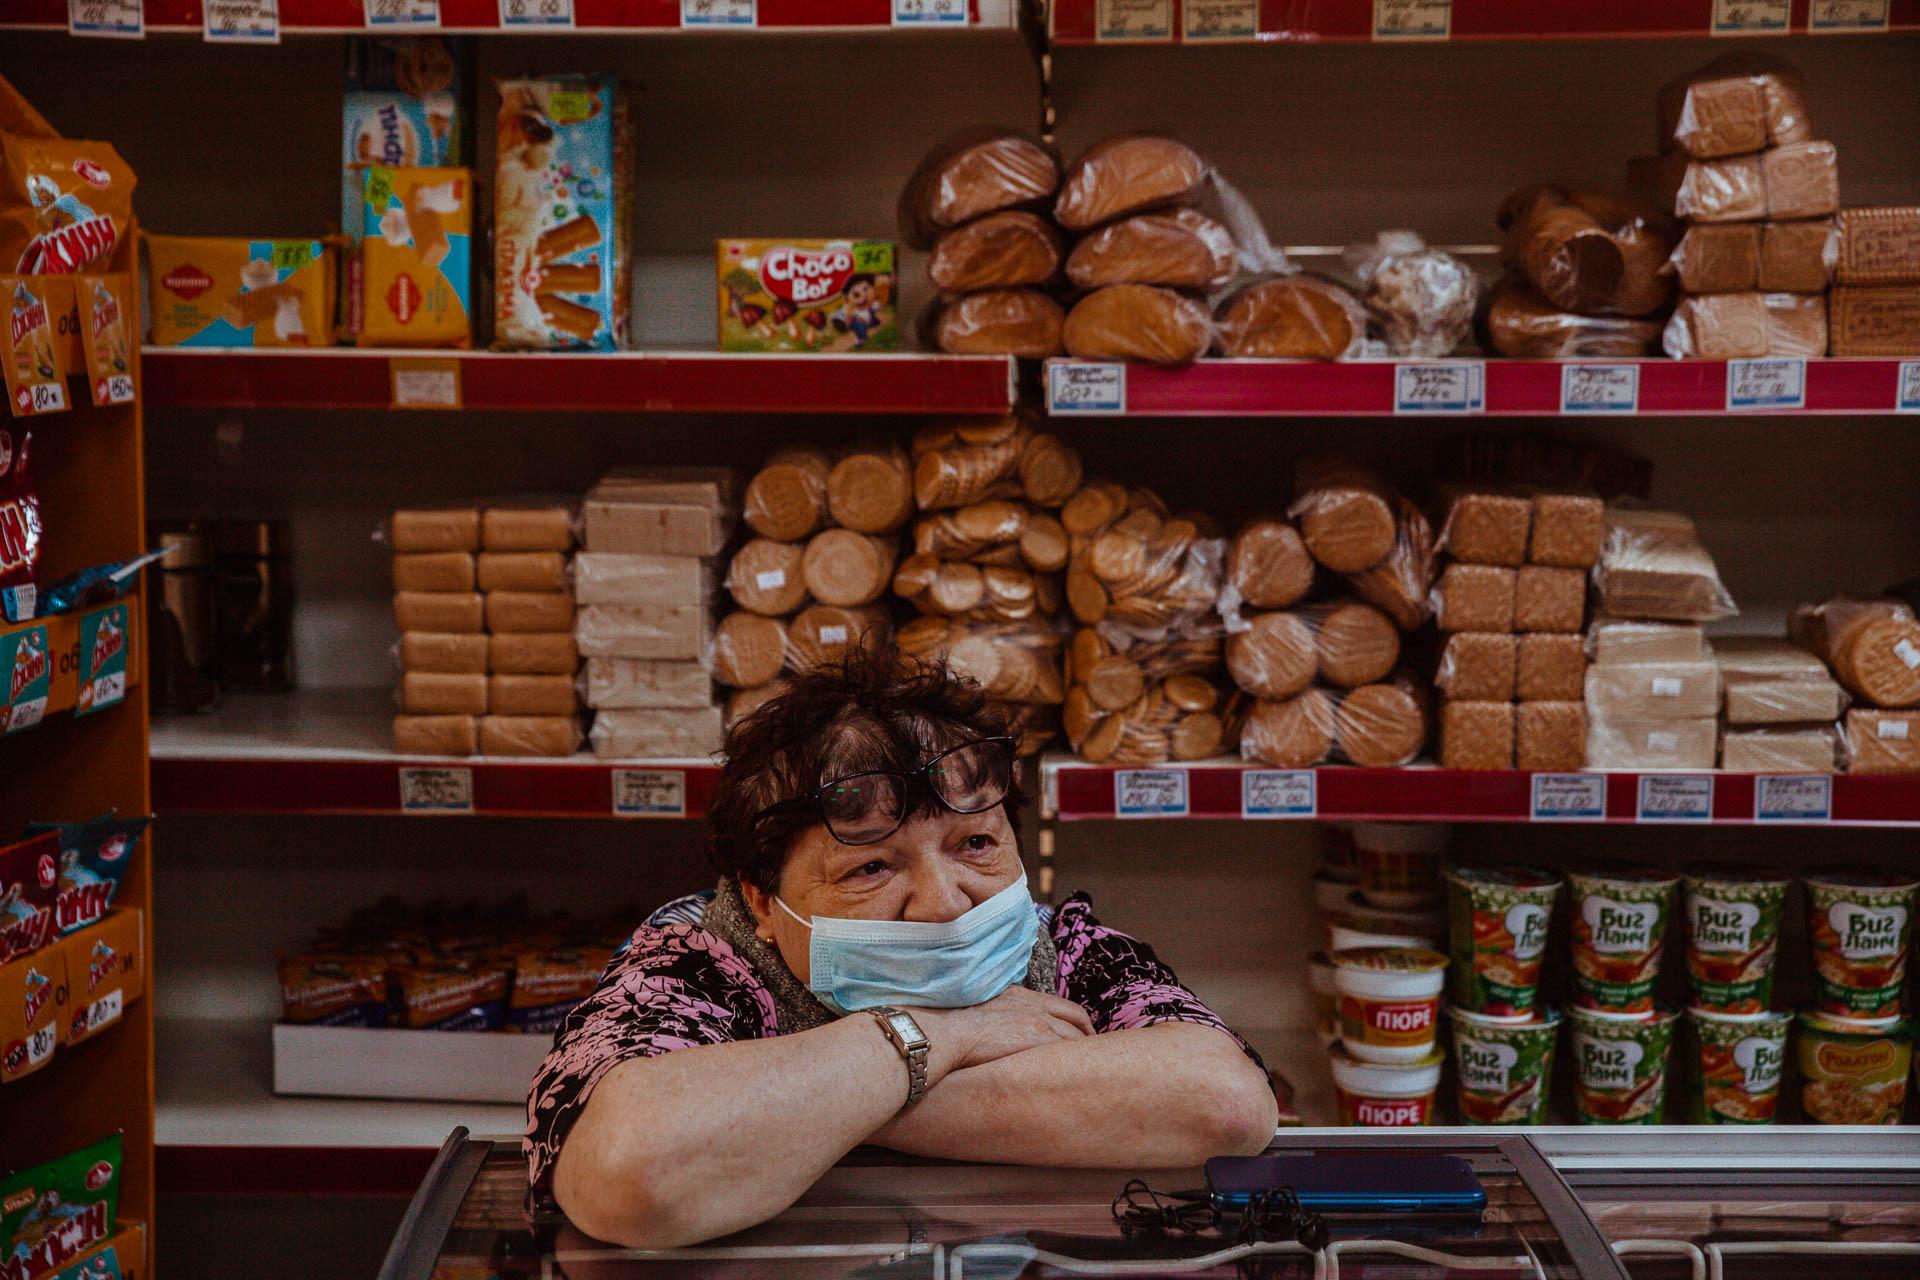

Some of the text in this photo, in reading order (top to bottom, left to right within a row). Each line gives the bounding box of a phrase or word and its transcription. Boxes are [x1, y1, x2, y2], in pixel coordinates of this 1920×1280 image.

[766, 251, 850, 281] Choco
[1600, 907, 1645, 929] Биг
[1699, 906, 1743, 928] Биг
[1850, 913, 1894, 934] Биг
[1375, 1007, 1432, 1032] ПЮРЕ
[1583, 1043, 1625, 1067] Биг
[1358, 1104, 1421, 1126] ПЮРЕ
